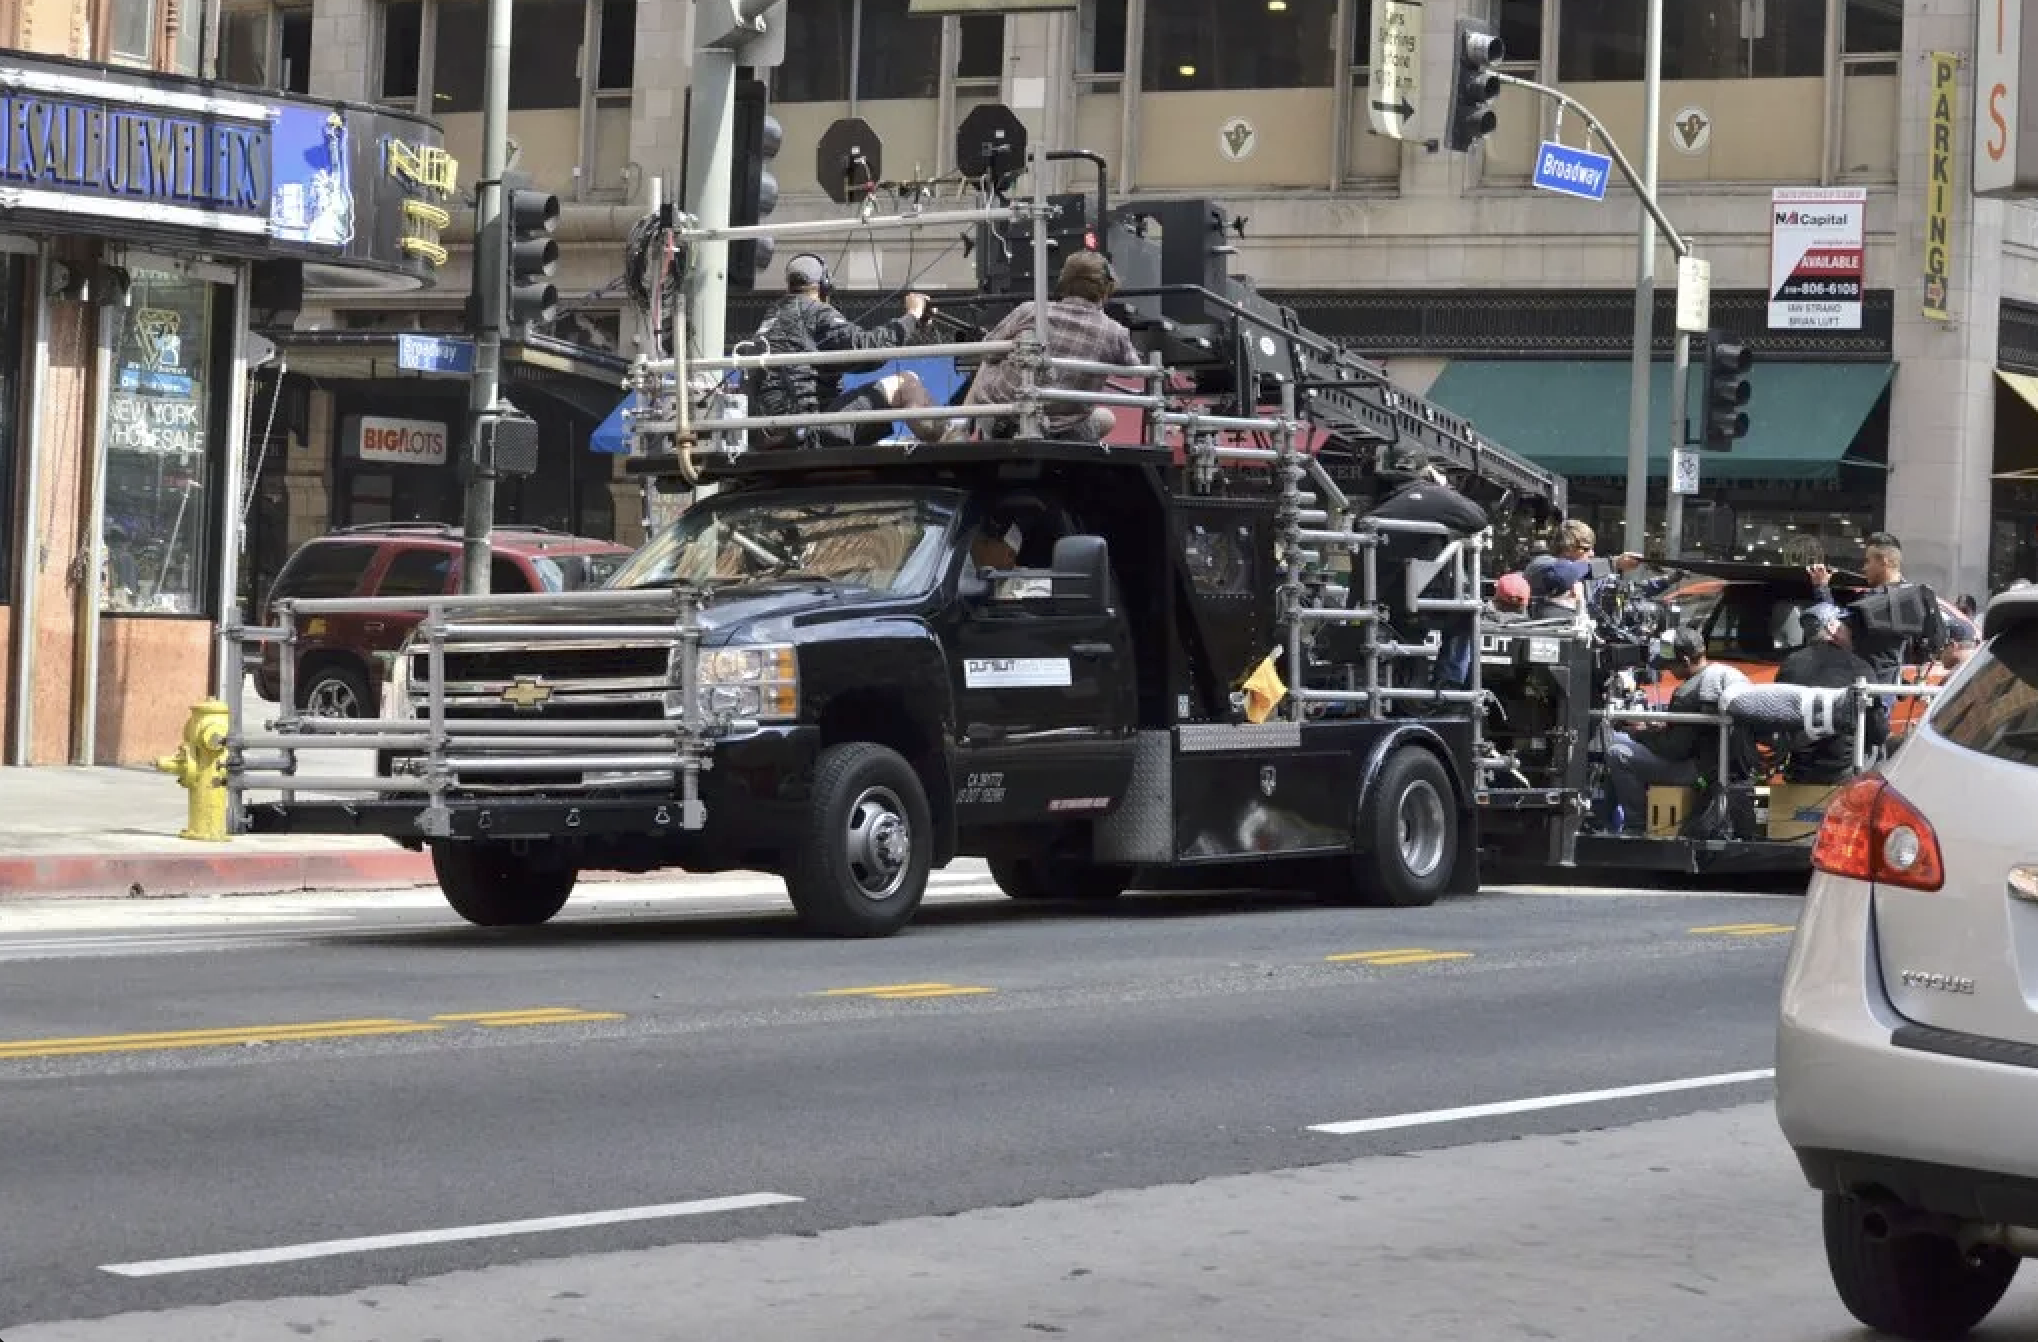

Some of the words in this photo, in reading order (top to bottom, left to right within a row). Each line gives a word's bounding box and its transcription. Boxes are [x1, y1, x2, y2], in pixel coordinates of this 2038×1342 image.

[0, 96, 102, 188] ESALE
[1543, 152, 1603, 191] Broadway
[1925, 61, 1952, 275] PARKING
[1800, 213, 1848, 227] Capital
[1801, 255, 1859, 269] AVAILABLE
[151, 402, 199, 426] YORK
